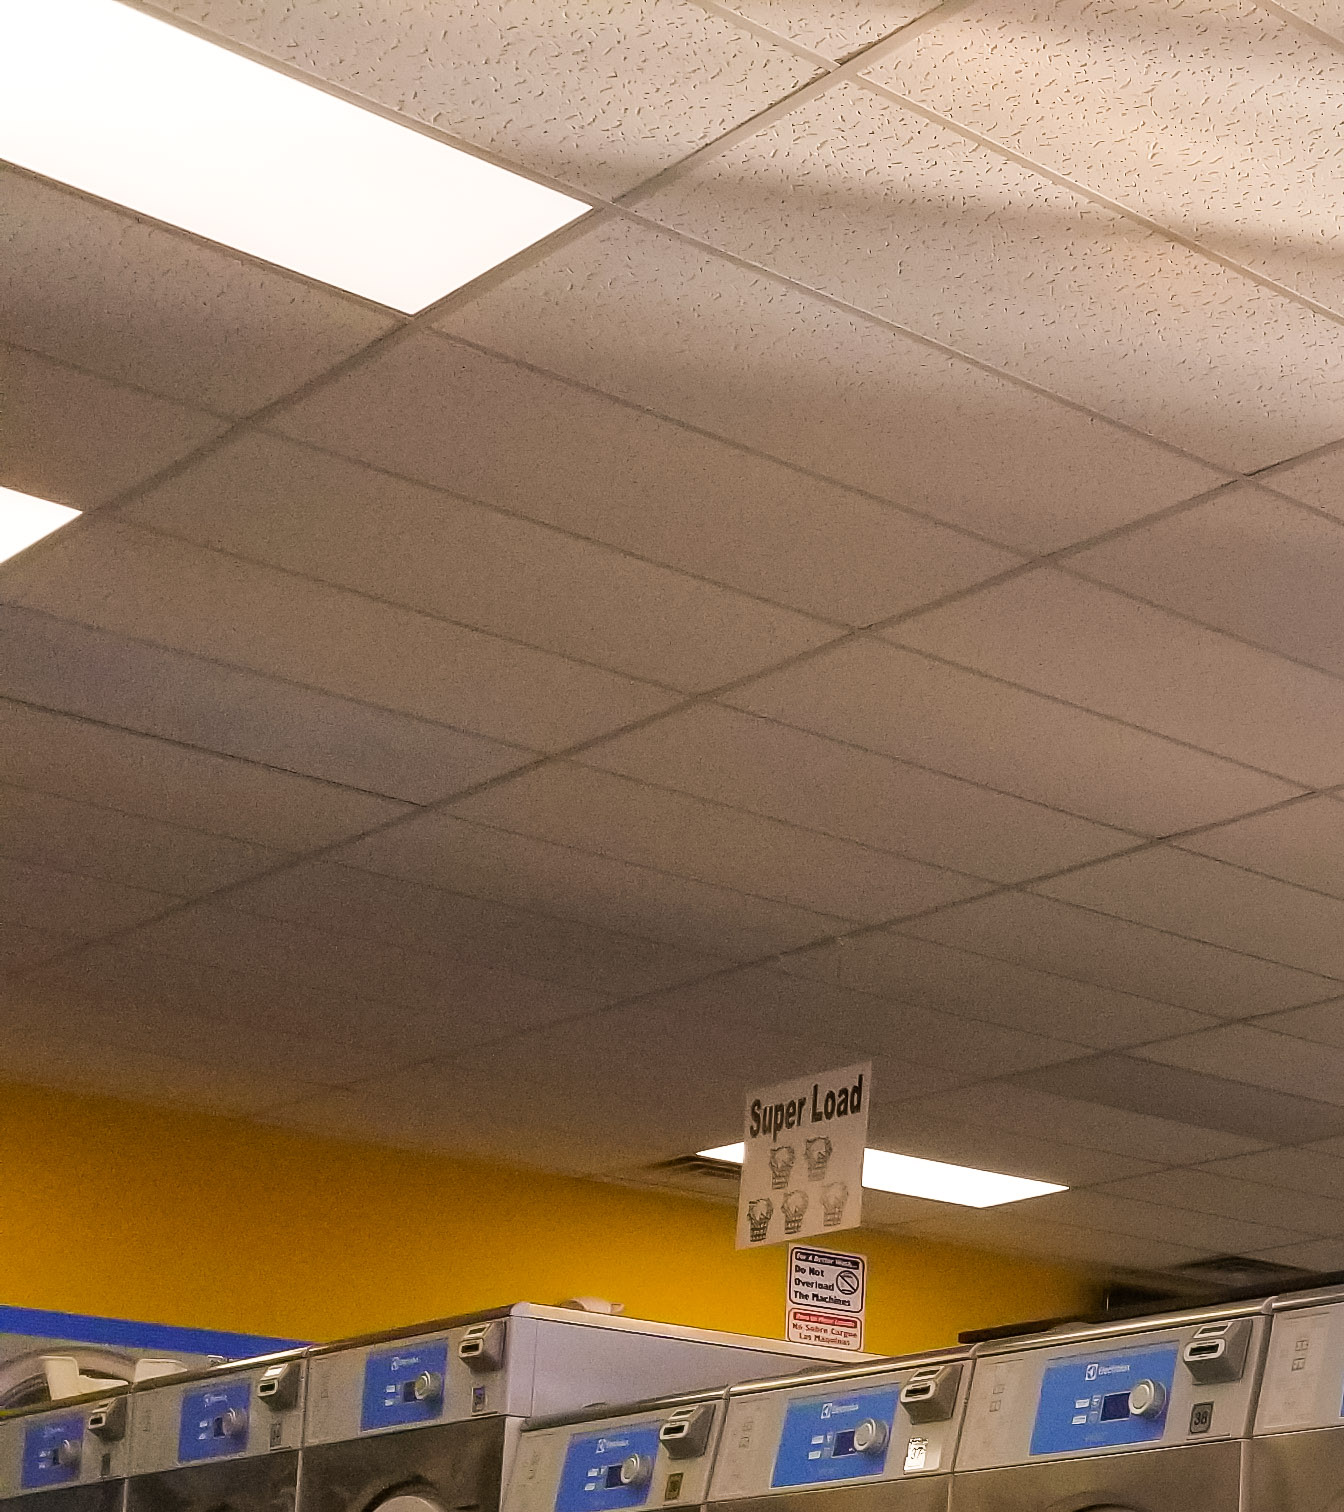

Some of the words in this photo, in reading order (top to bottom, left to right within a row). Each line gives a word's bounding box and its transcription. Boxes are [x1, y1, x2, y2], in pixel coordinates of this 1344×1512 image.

[750, 1097, 806, 1142] Super
[811, 1074, 863, 1123] Load
[795, 1265, 806, 1275] Do
[809, 1267, 824, 1277] Not
[794, 1278, 835, 1291] Overload
[794, 1290, 809, 1300] The
[812, 1293, 850, 1306] Machines
